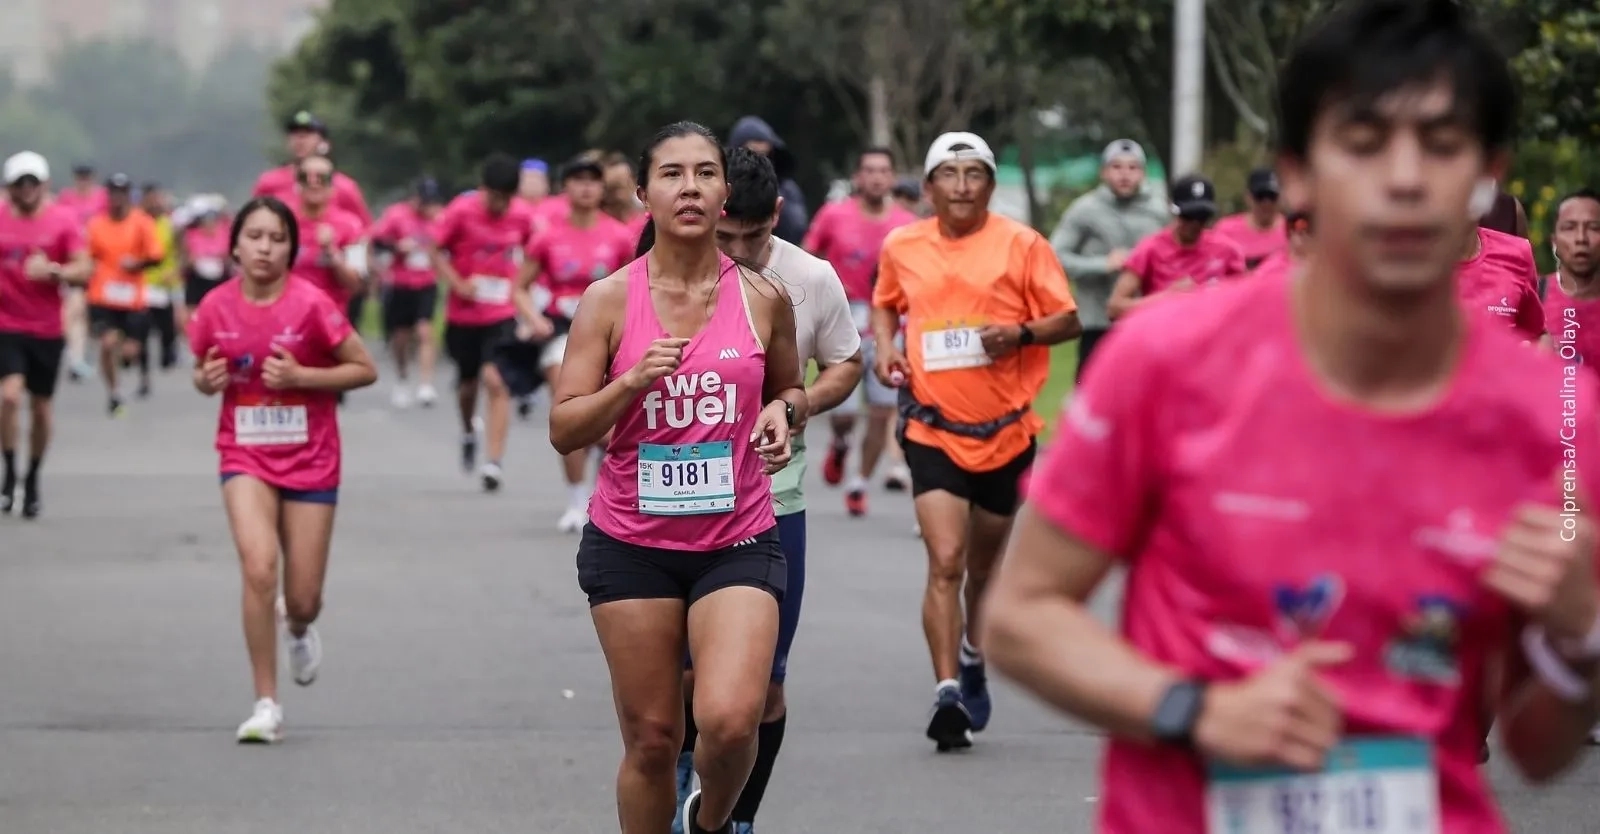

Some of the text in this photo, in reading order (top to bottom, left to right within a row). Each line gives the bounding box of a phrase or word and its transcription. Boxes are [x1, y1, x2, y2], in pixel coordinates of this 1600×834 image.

[664, 371, 721, 397] we
[640, 462, 652, 470] 15K
[662, 461, 708, 486] 9181
